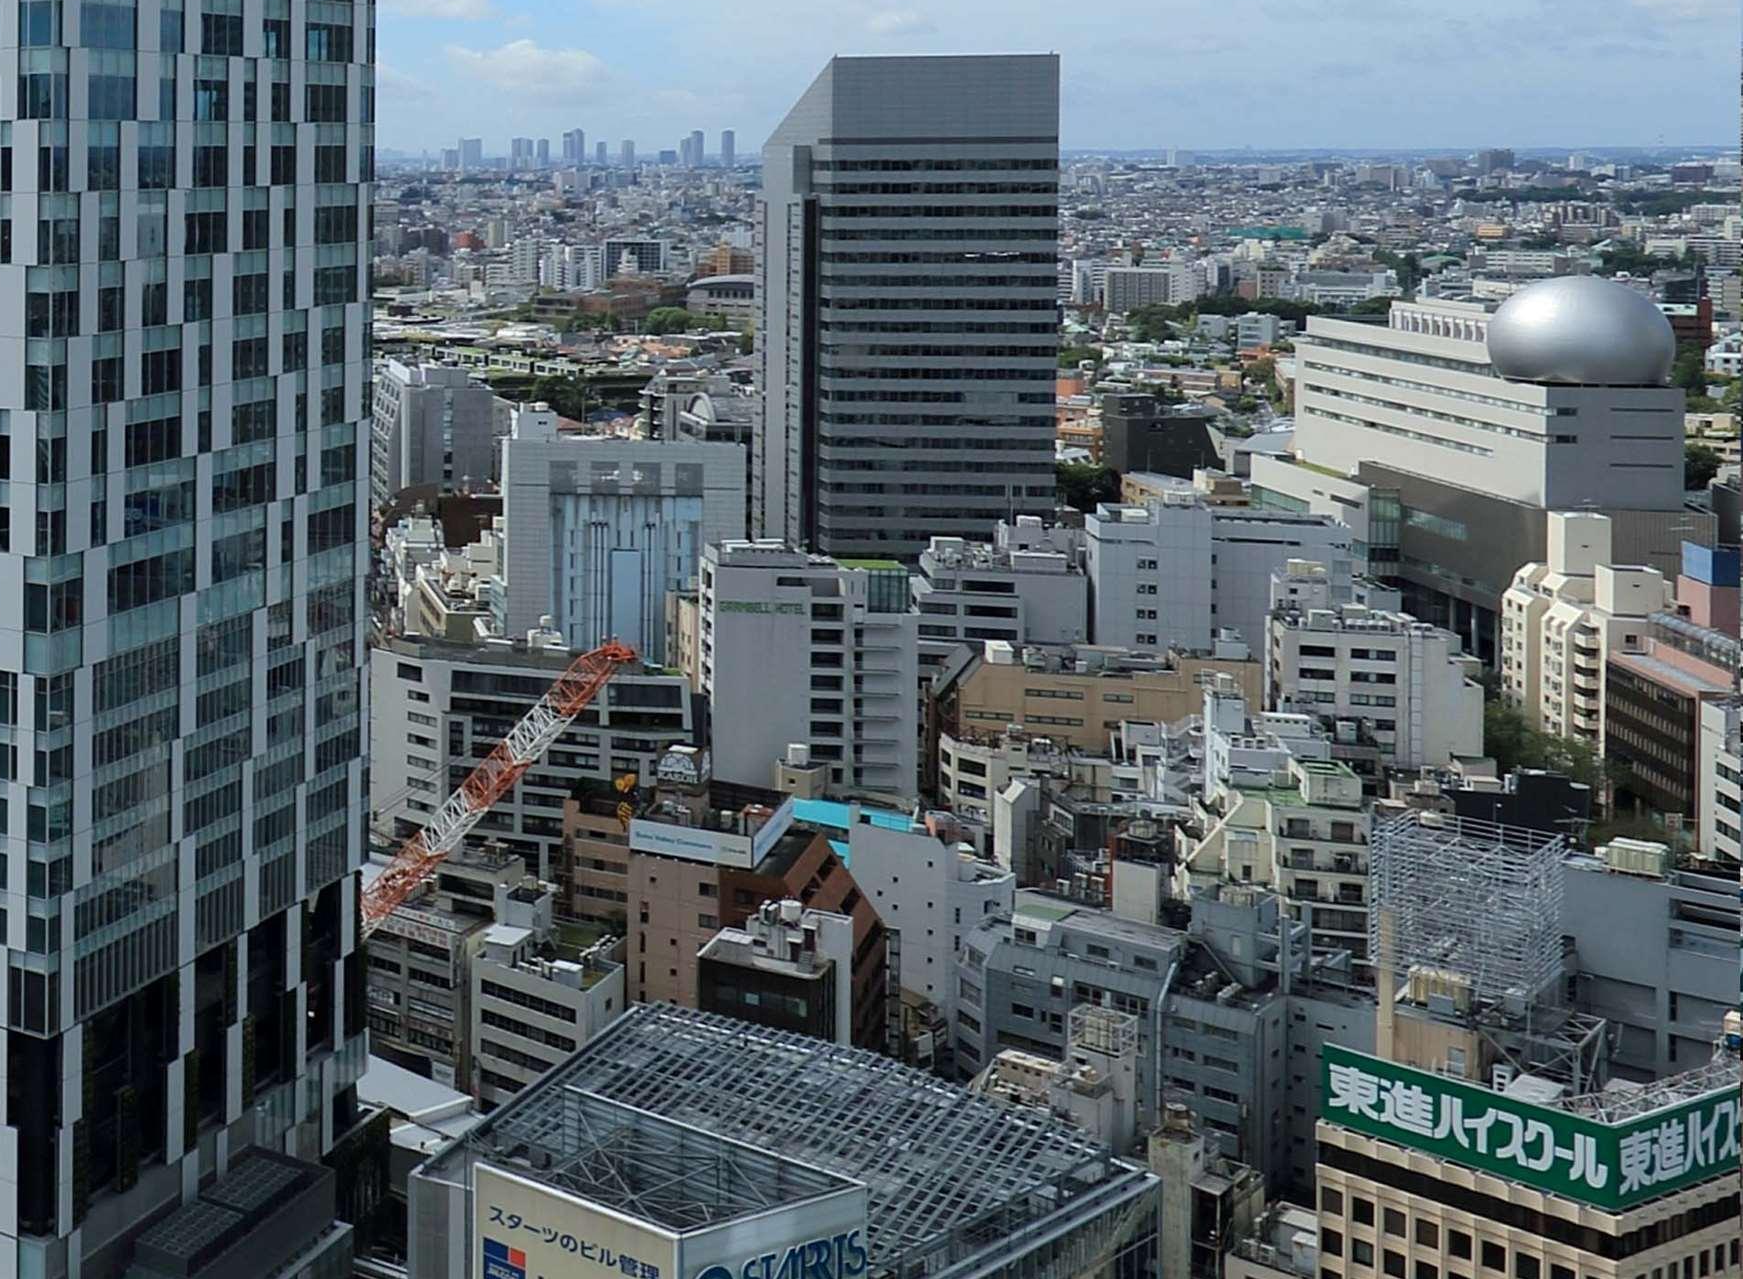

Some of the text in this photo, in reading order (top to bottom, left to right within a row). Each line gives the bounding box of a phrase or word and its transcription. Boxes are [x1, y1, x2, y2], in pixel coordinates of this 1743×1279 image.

[1328, 1063, 1608, 1188] 東進ハイスクール
[1619, 1098, 1741, 1195] 東進ハイス
